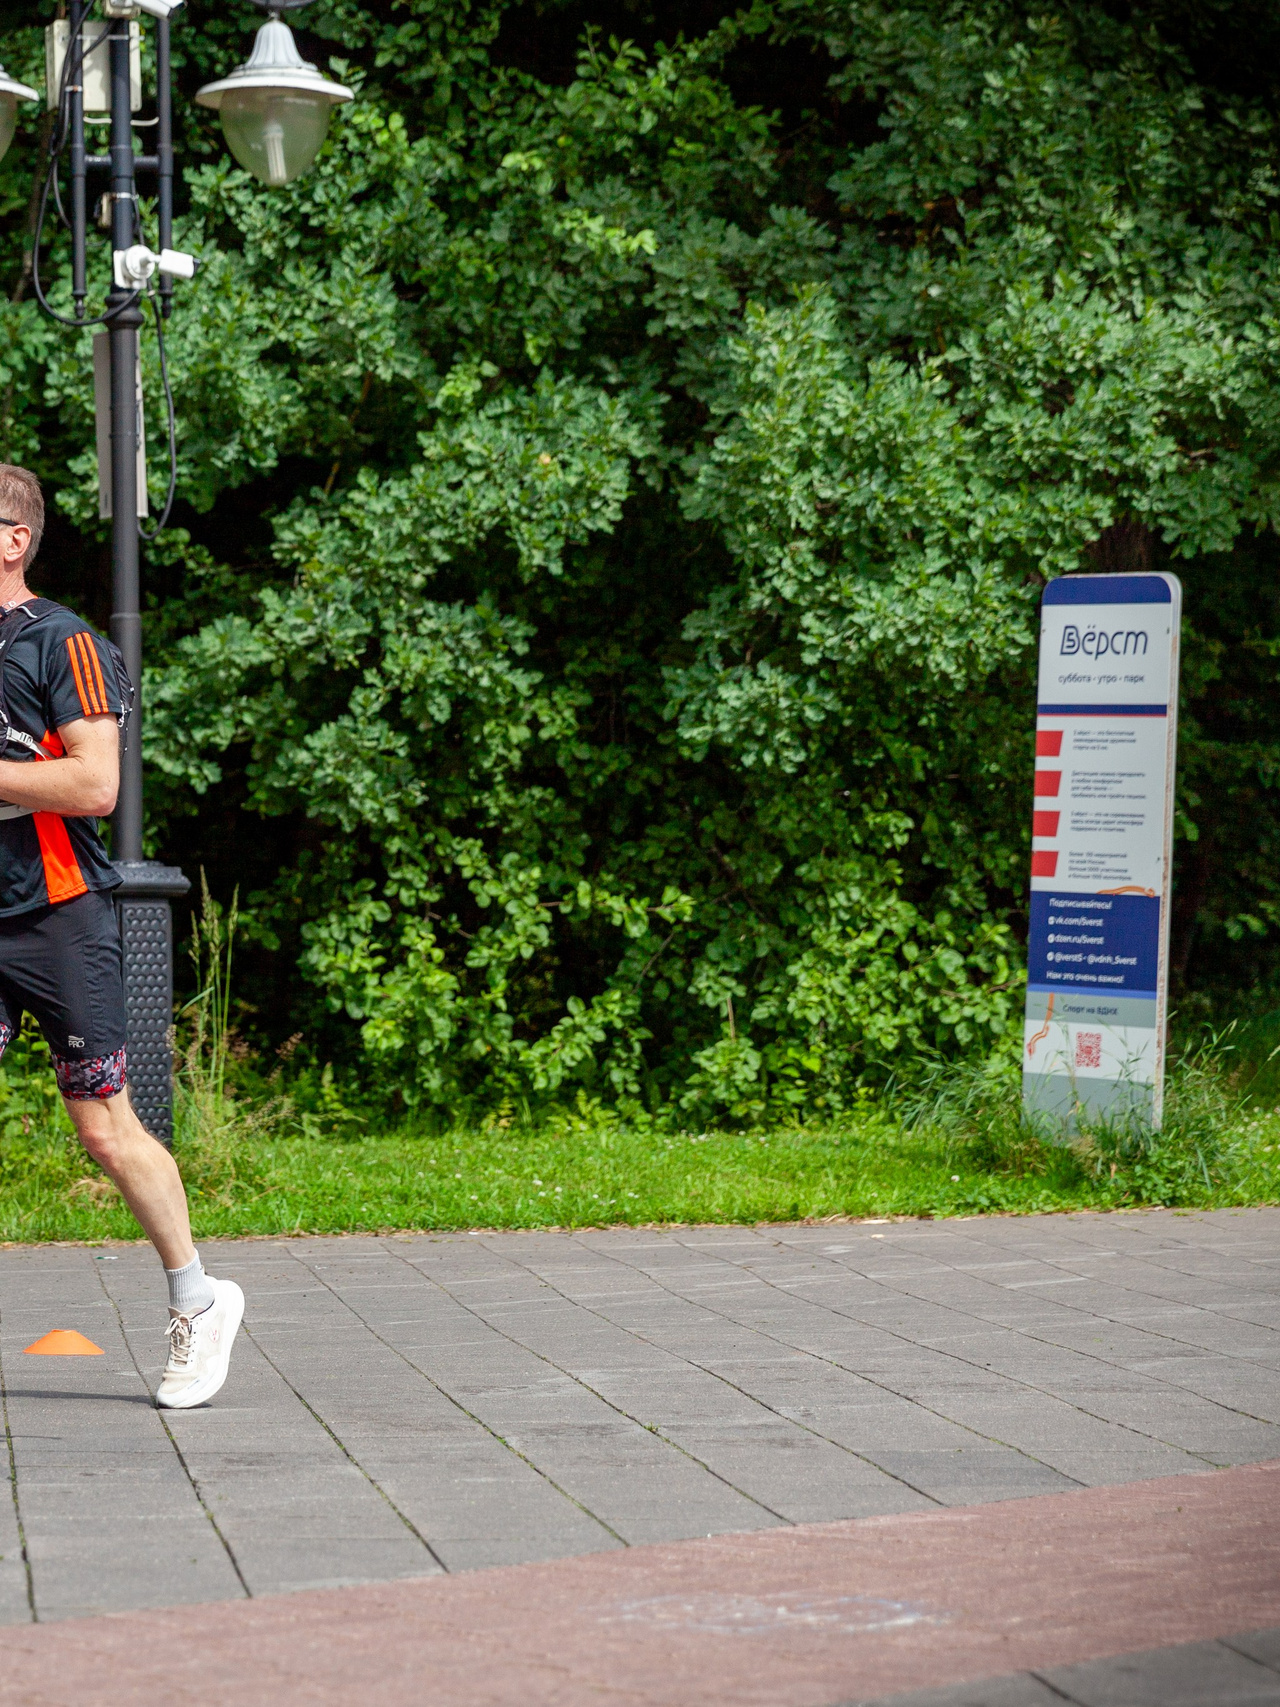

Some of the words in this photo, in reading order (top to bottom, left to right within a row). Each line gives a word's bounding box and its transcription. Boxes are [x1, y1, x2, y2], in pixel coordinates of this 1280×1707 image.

[1058, 672, 1091, 685] суббота
[1098, 674, 1117, 685] утро
[1124, 675, 1145, 684] парк
[1049, 898, 1113, 910] Подписывайтесь!
[1055, 916, 1104, 927] vk.com/5verst
[1046, 970, 1062, 980] Нам
[1075, 973, 1097, 983] очень
[1097, 975, 1125, 984] важно!
[1063, 1004, 1085, 1015] Спорт
[68, 1040, 85, 1048] PRO
